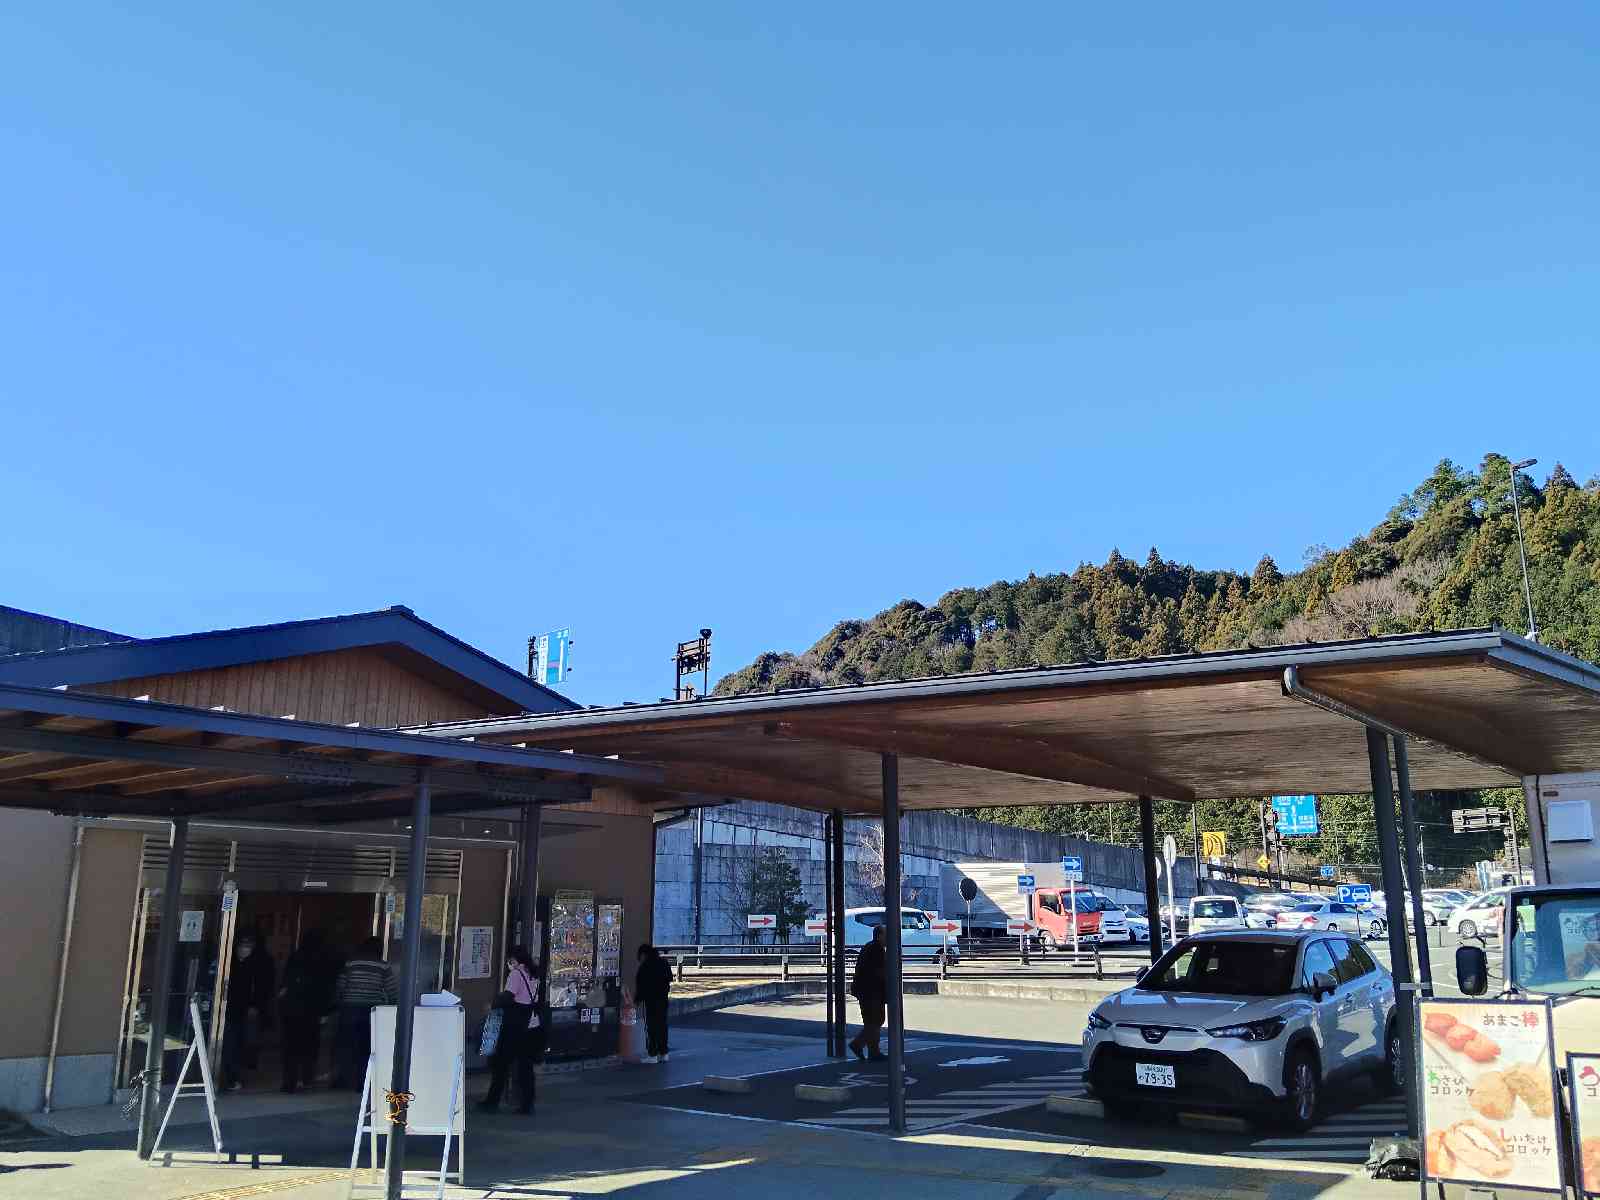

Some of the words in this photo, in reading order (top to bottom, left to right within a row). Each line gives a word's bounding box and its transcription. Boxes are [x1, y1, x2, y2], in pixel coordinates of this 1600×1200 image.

[1339, 886, 1351, 903] P
[1483, 1011, 1539, 1029] あまこ棒
[1430, 1086, 1475, 1097] コロッケ
[1500, 1127, 1547, 1145] しいたけ
[1505, 1144, 1553, 1156] コロッケ
